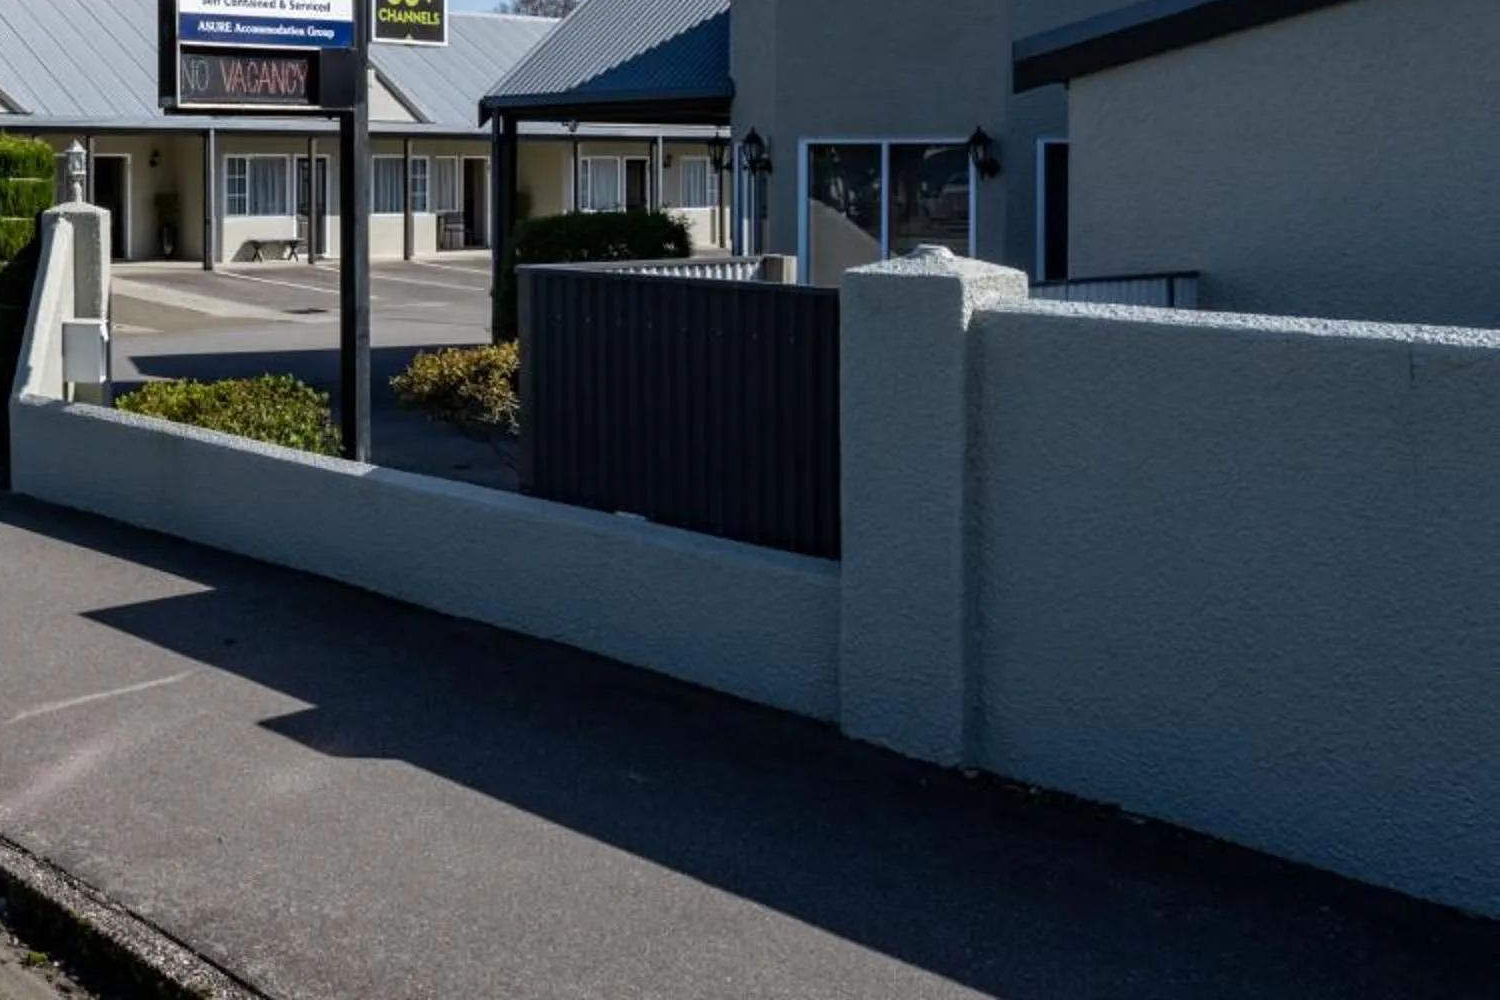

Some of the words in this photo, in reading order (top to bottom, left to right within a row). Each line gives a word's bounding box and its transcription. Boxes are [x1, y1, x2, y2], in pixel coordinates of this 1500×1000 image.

[279, 0, 287, 10] &
[289, 0, 331, 13] Serviced
[379, 8, 440, 26] CHANNELS
[197, 20, 232, 34] ASURE
[235, 22, 305, 37] Accommodation
[307, 25, 336, 39] Group
[181, 57, 210, 92] NO
[218, 58, 309, 96] VACANCY
